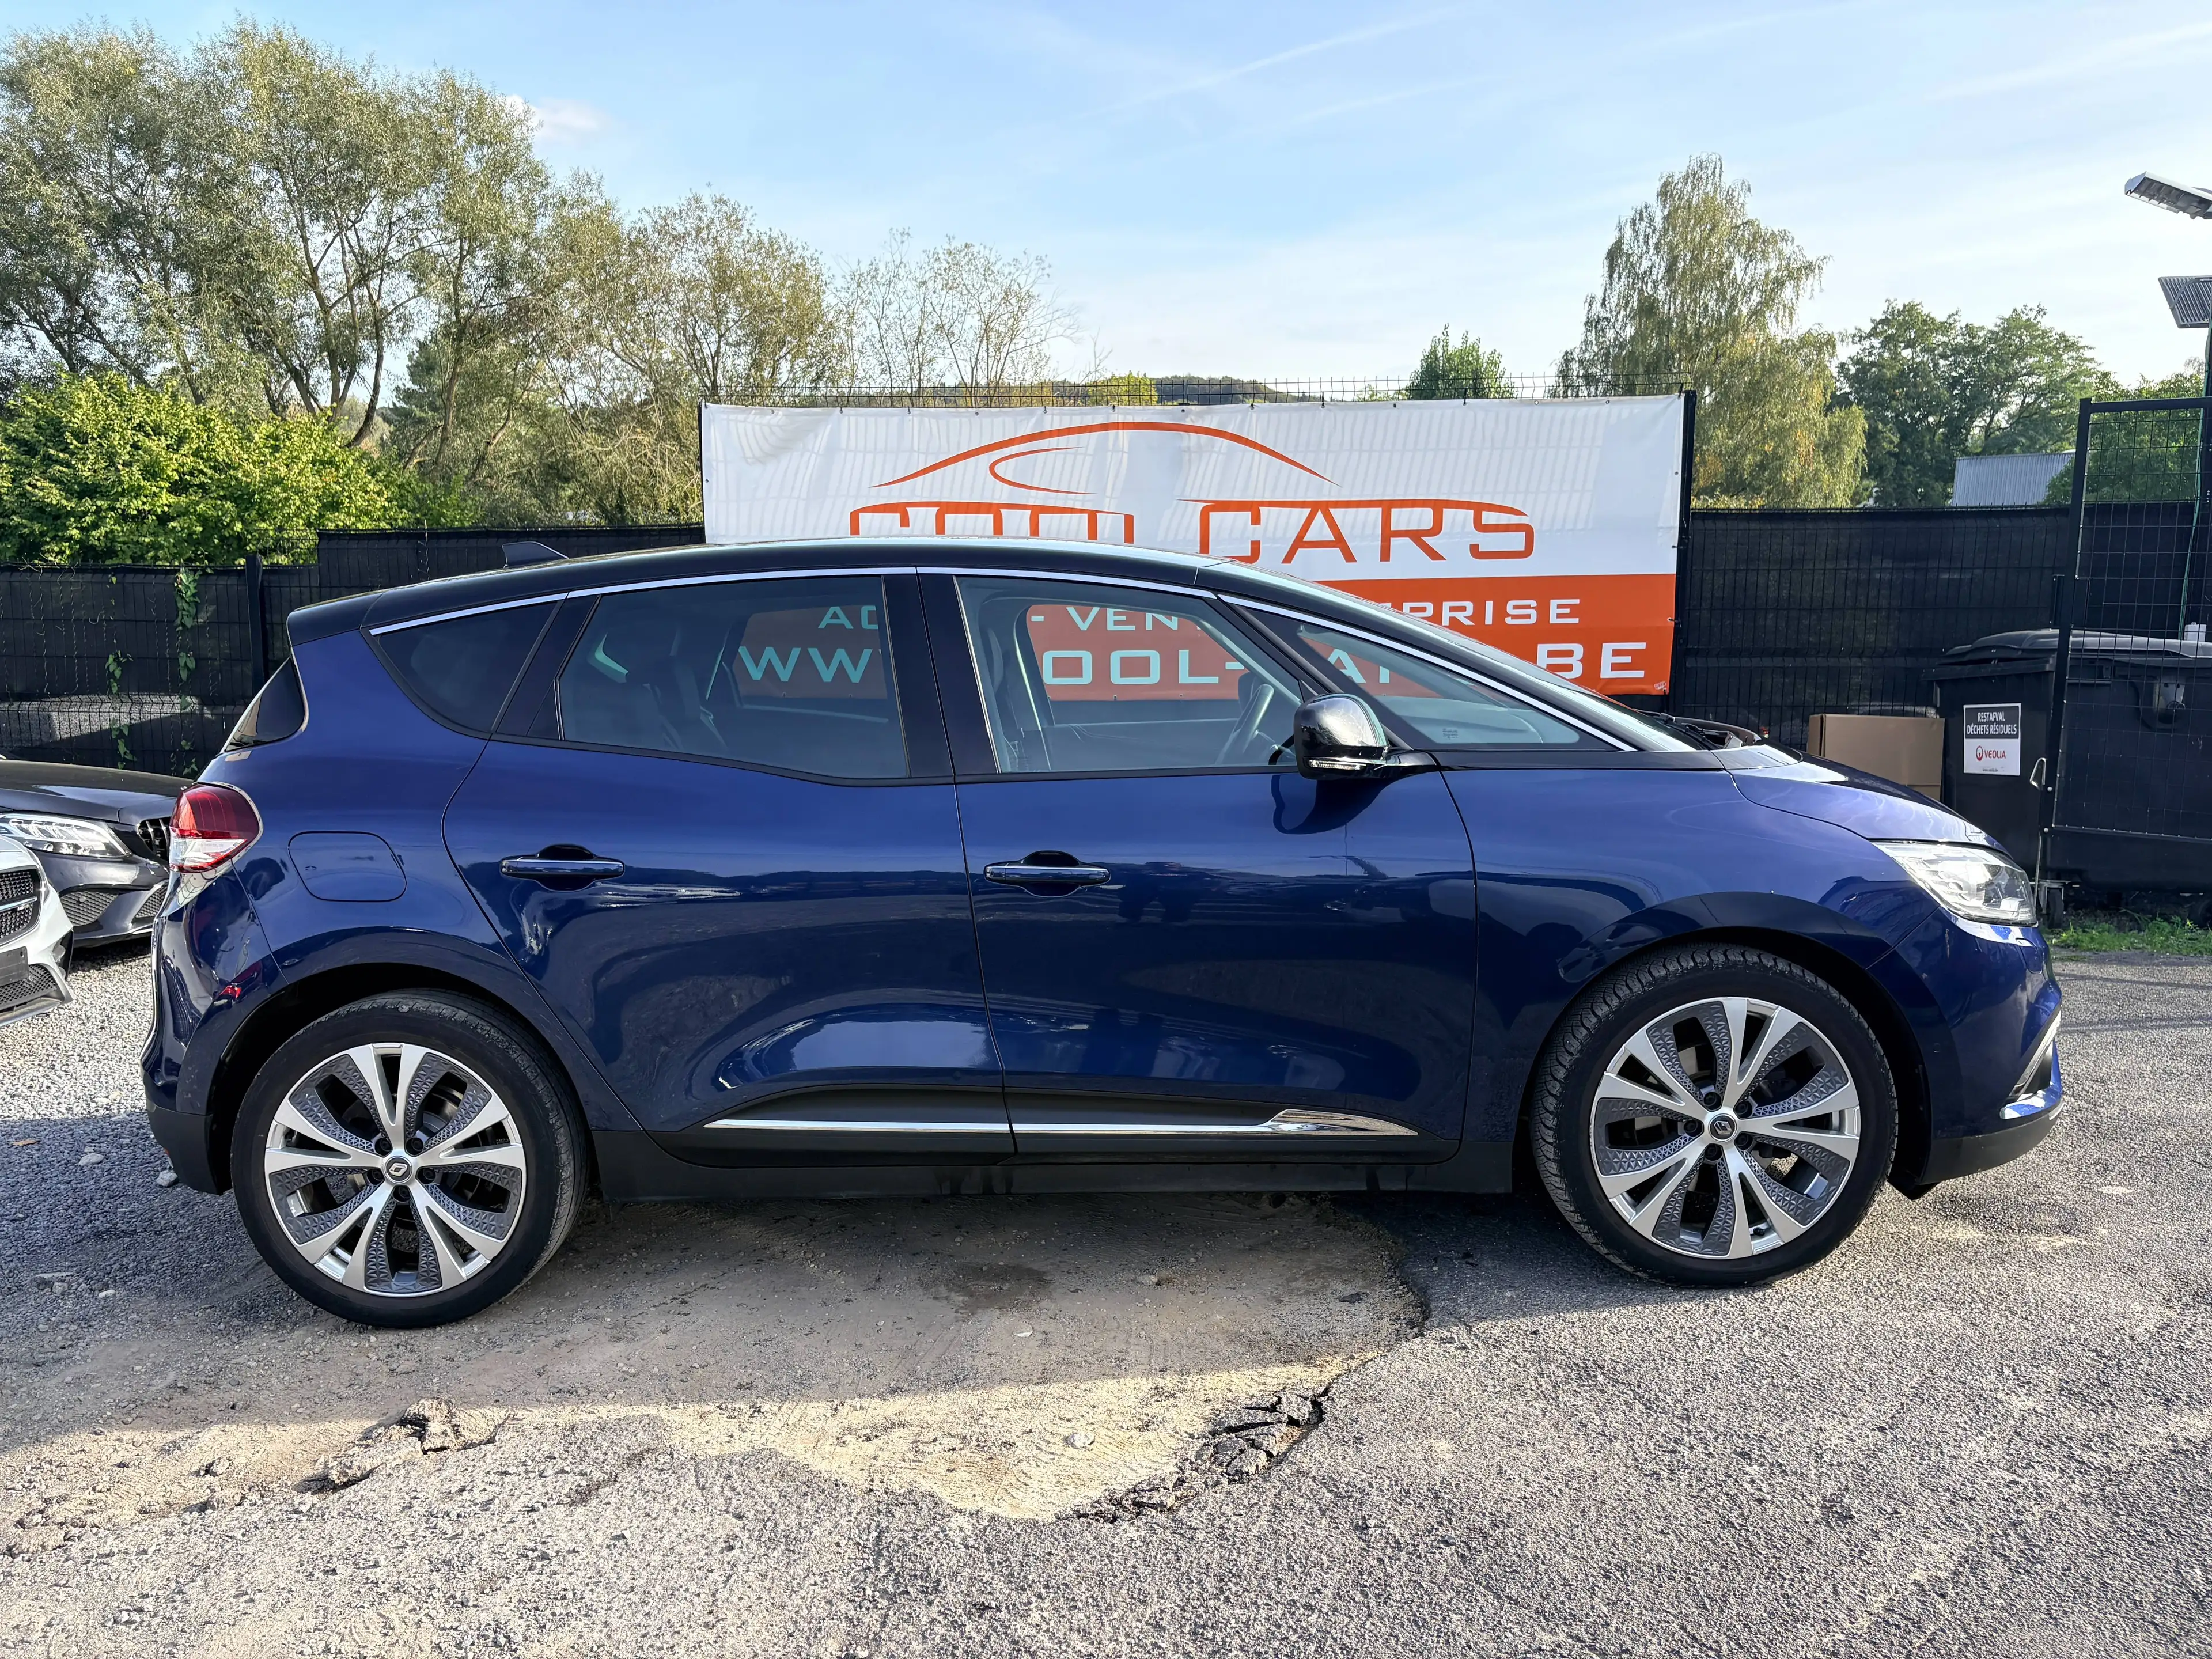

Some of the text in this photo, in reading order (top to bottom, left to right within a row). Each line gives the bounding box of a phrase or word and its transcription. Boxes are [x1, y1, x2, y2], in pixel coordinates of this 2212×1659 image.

[1197, 499, 1535, 565] CARS
[1066, 607, 1202, 631] VEN
[1379, 599, 1580, 626] PRISE
[1978, 711, 2005, 722] RESTAFVAL
[1967, 722, 2017, 734] DÉCHETS RÉSIDUELS
[1984, 749, 2006, 759] VEOLIA
